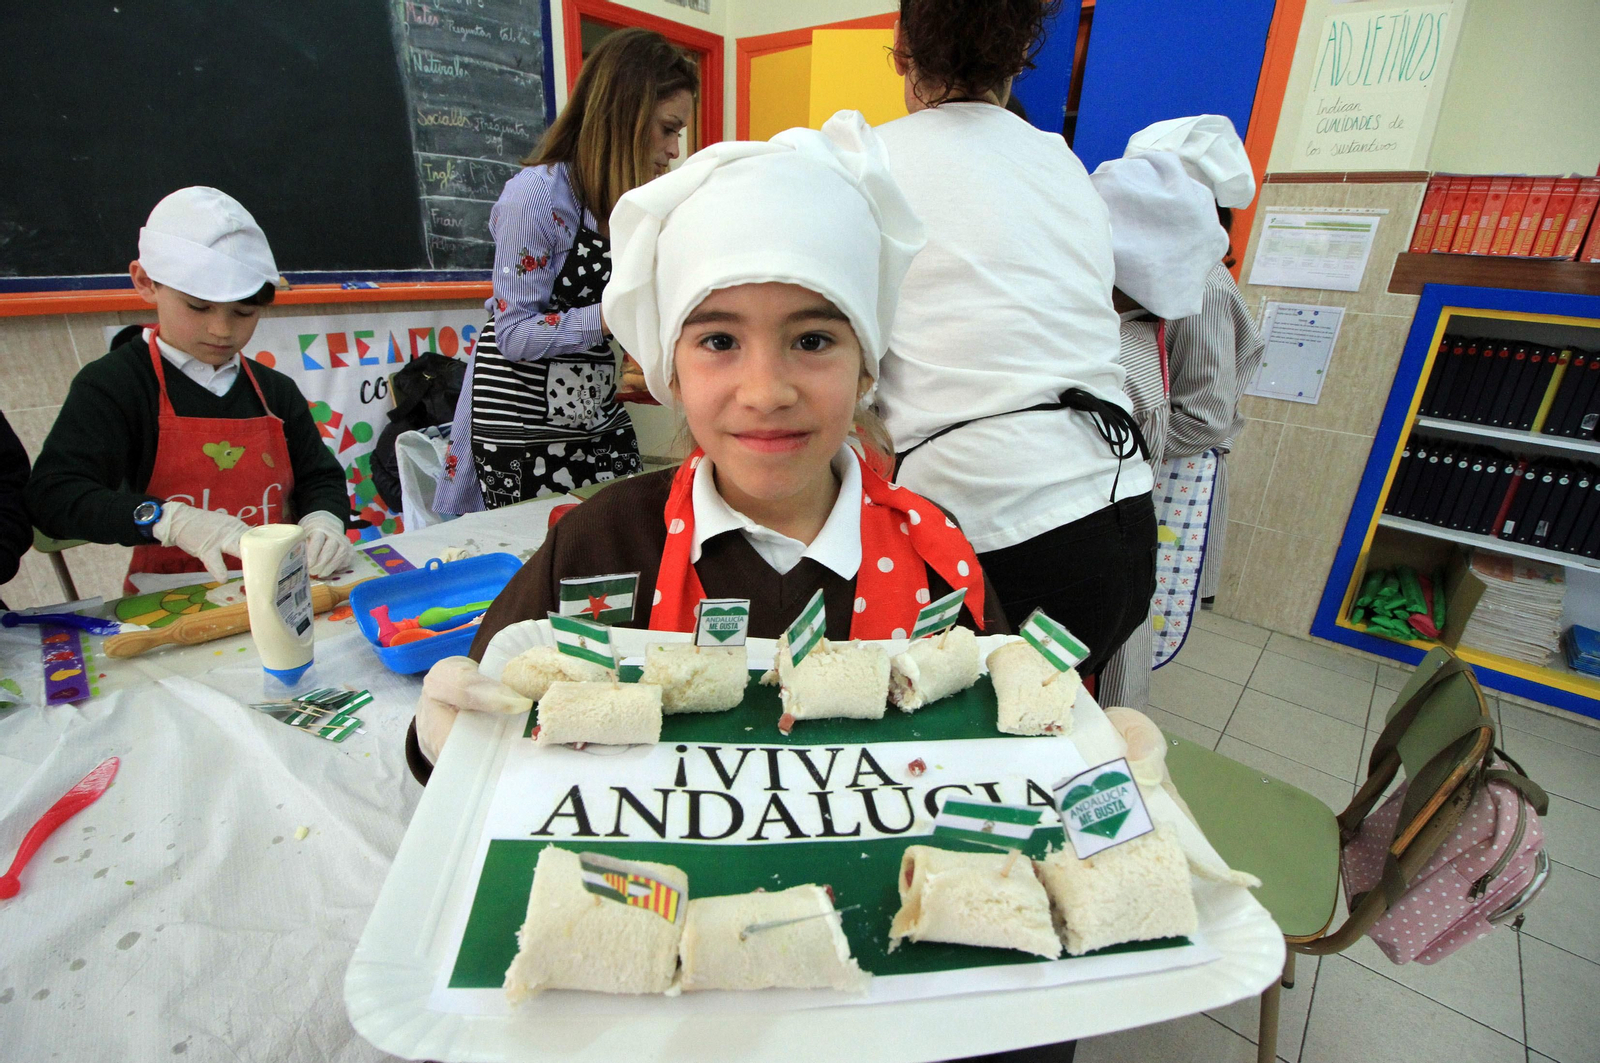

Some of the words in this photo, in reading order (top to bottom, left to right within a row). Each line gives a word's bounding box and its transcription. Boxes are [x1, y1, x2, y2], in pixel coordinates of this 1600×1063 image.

[1314, 10, 1448, 91] ADJETIVOS
[1316, 97, 1362, 116] Indican
[1316, 115, 1382, 134] CUALIDADES
[1388, 115, 1404, 130] de
[705, 615, 744, 624] ANDALUCÍA
[720, 622, 738, 630] GUSTA
[675, 744, 904, 791] ¡VIVA
[1070, 786, 1128, 819] ANDALUCÍA
[1078, 812, 1094, 827] ME
[1094, 799, 1126, 819] GUSTA
